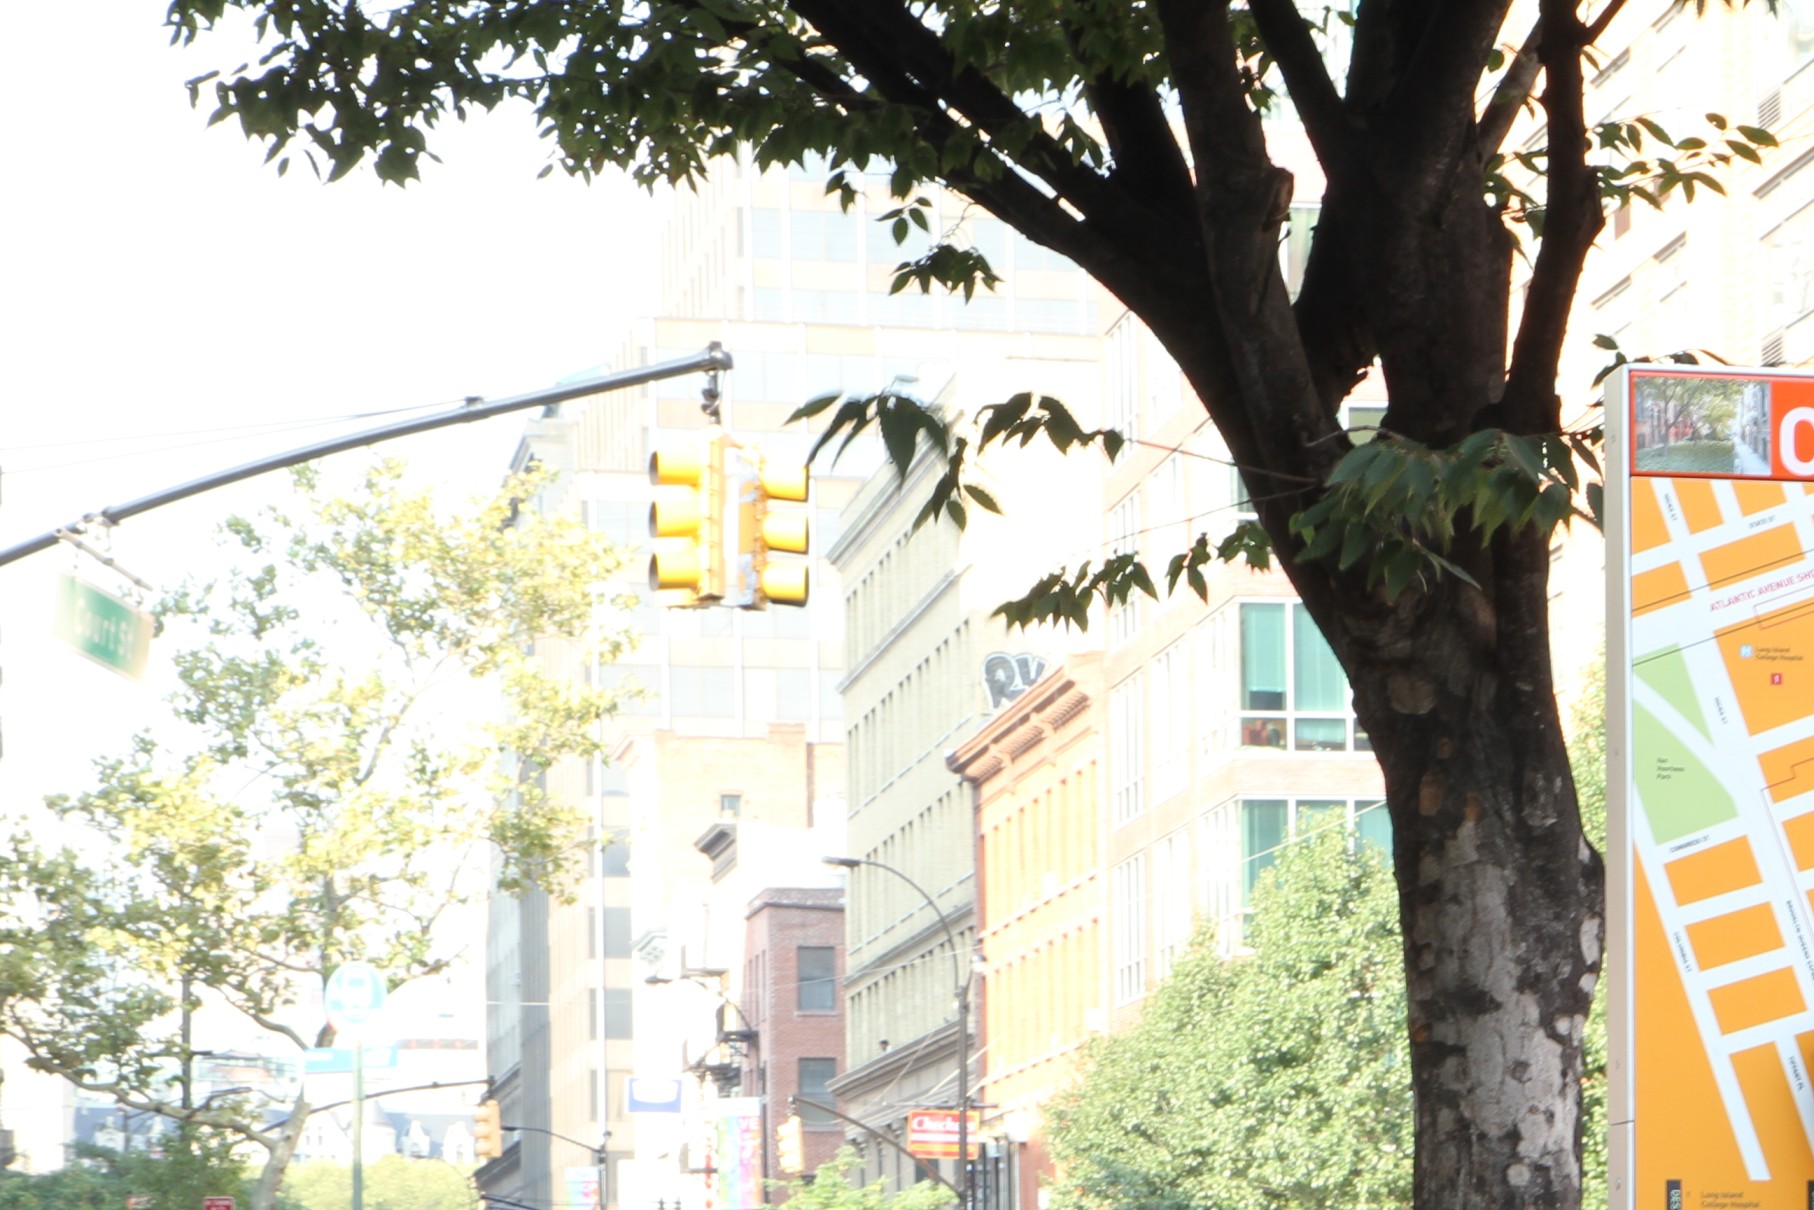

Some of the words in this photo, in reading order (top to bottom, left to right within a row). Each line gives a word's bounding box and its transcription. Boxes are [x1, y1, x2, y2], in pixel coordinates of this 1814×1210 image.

[1710, 589, 1757, 612] ATLANTIC
[1758, 576, 1796, 596] AVENUE
[76, 597, 117, 652] Court
